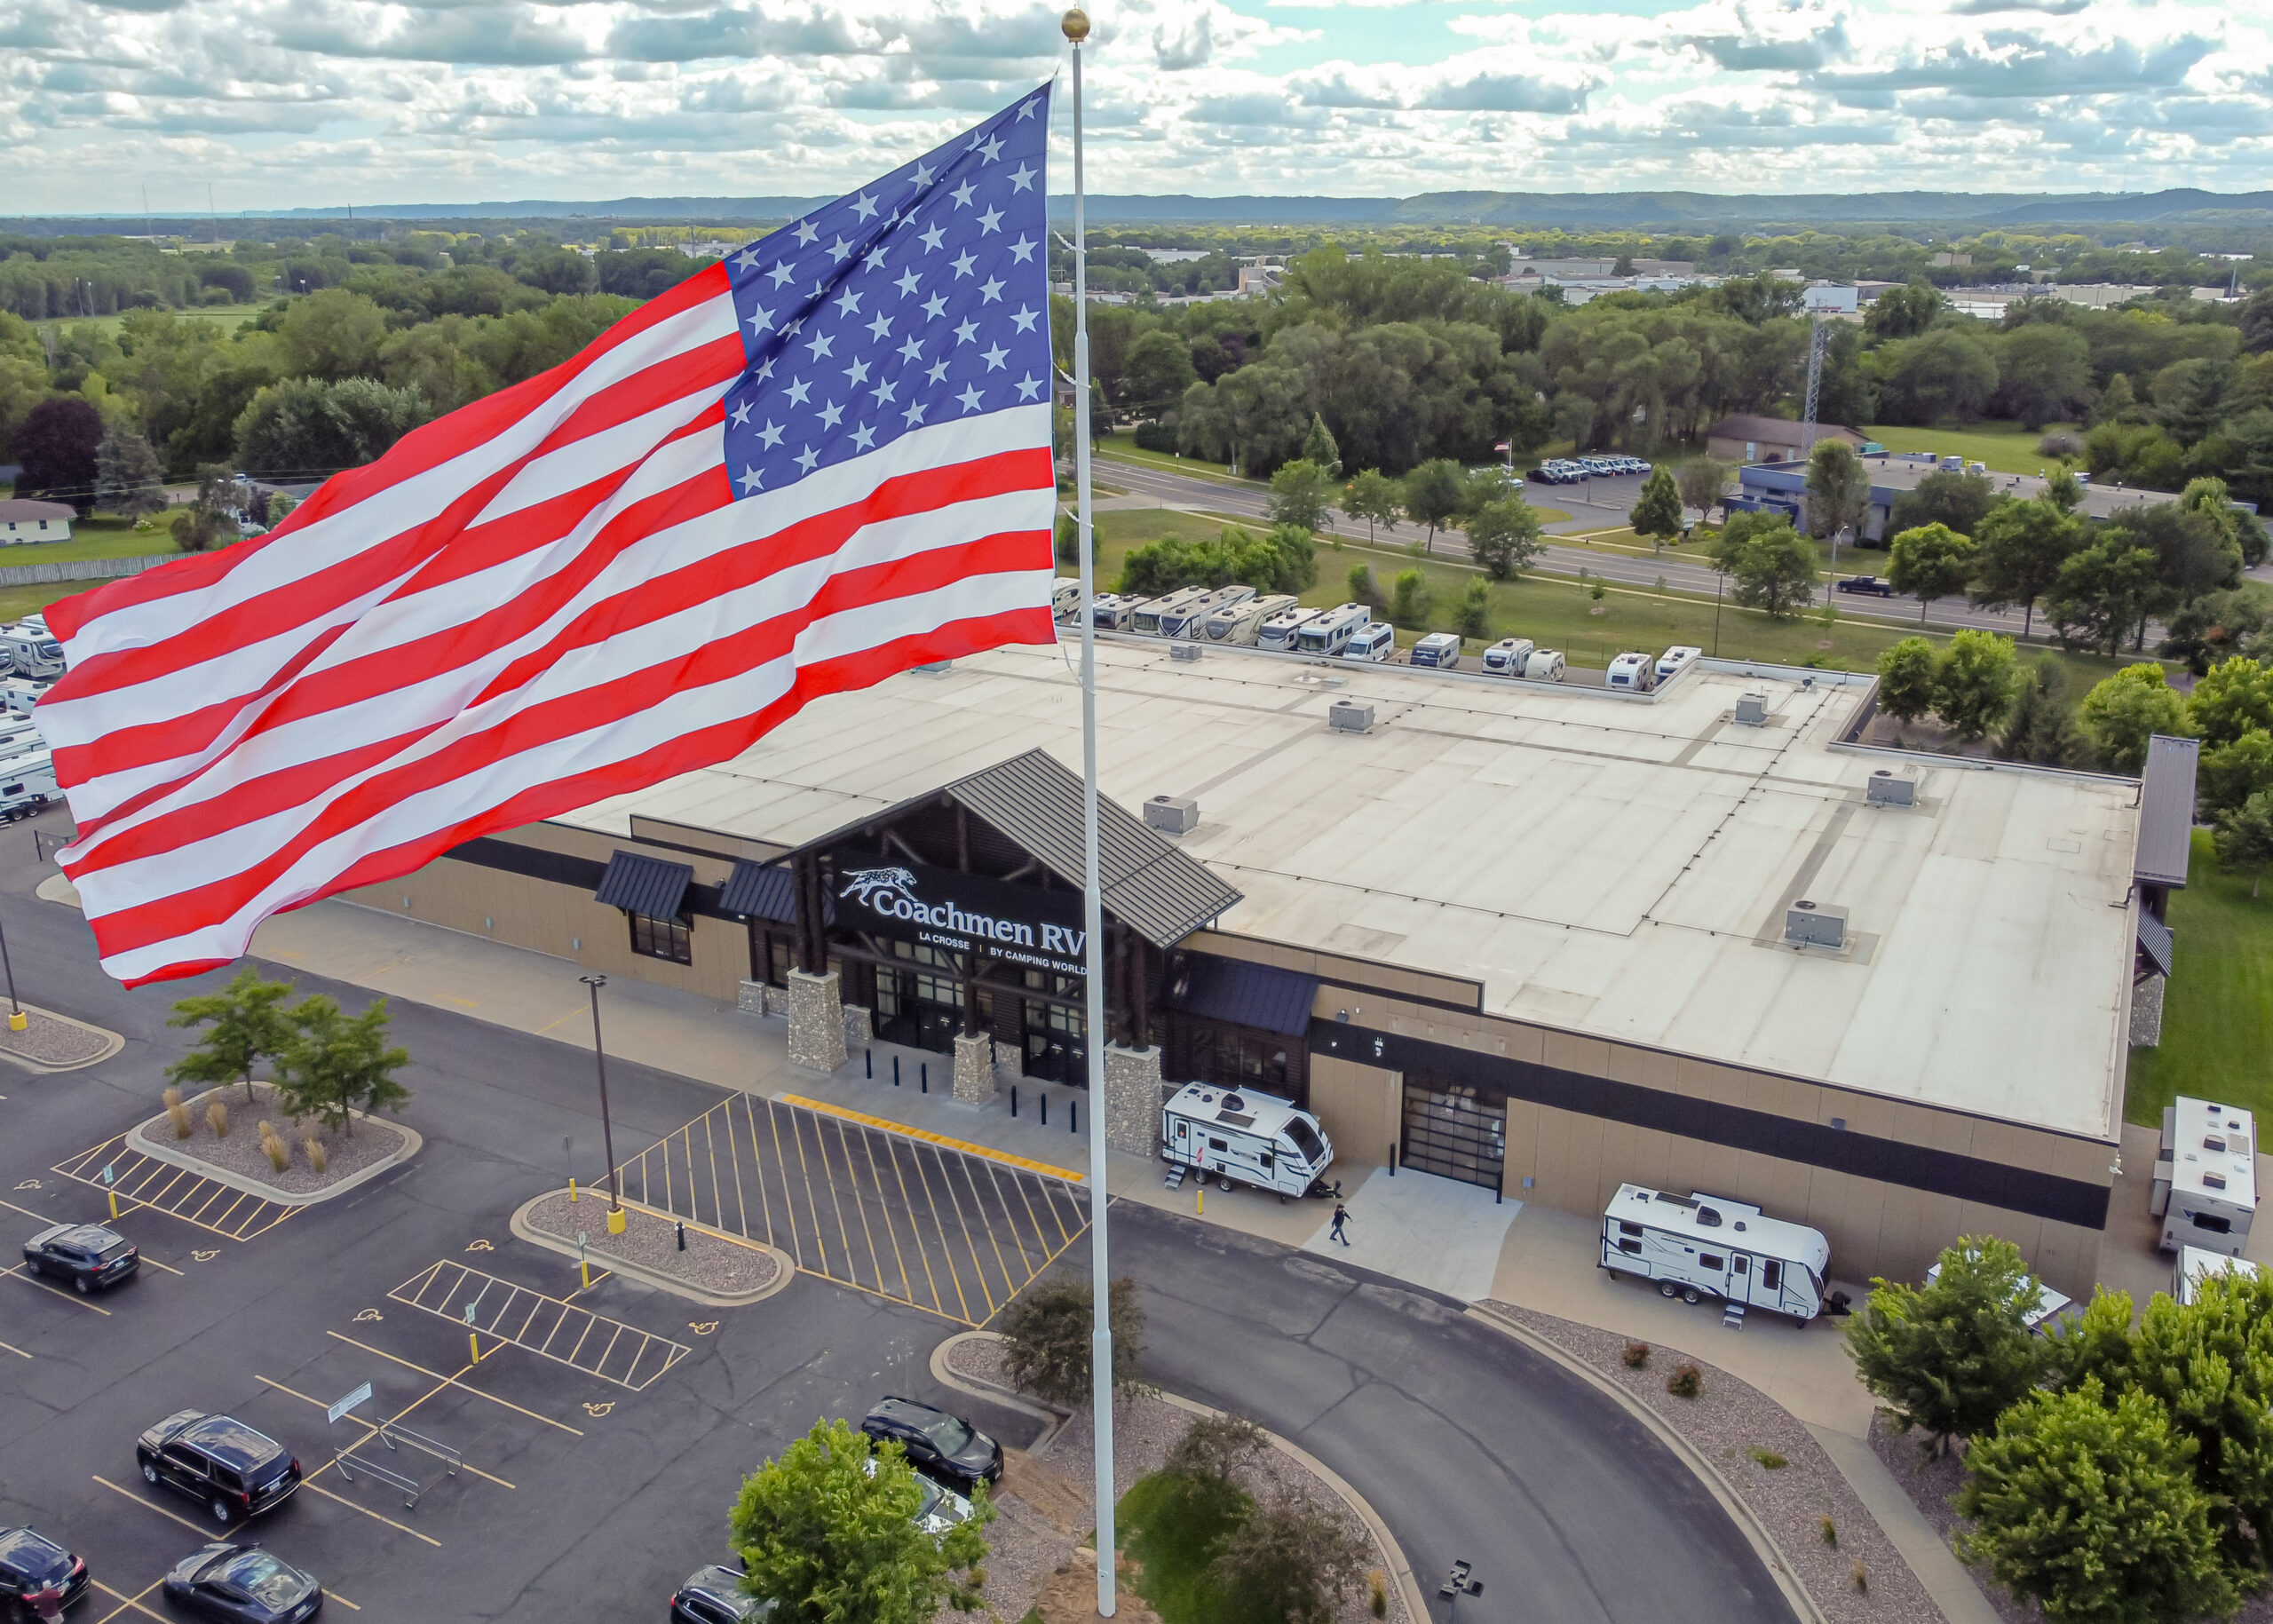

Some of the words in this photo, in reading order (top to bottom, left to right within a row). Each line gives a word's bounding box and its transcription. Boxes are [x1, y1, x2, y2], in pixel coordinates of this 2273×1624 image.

[873, 890, 1034, 947] Coachmen
[1040, 923, 1087, 956] RV
[919, 931, 931, 942] LA
[932, 934, 970, 950] CROSSE
[990, 947, 1003, 956] BY
[1005, 950, 1049, 967] CAMPING
[1052, 960, 1087, 975] WORLD
